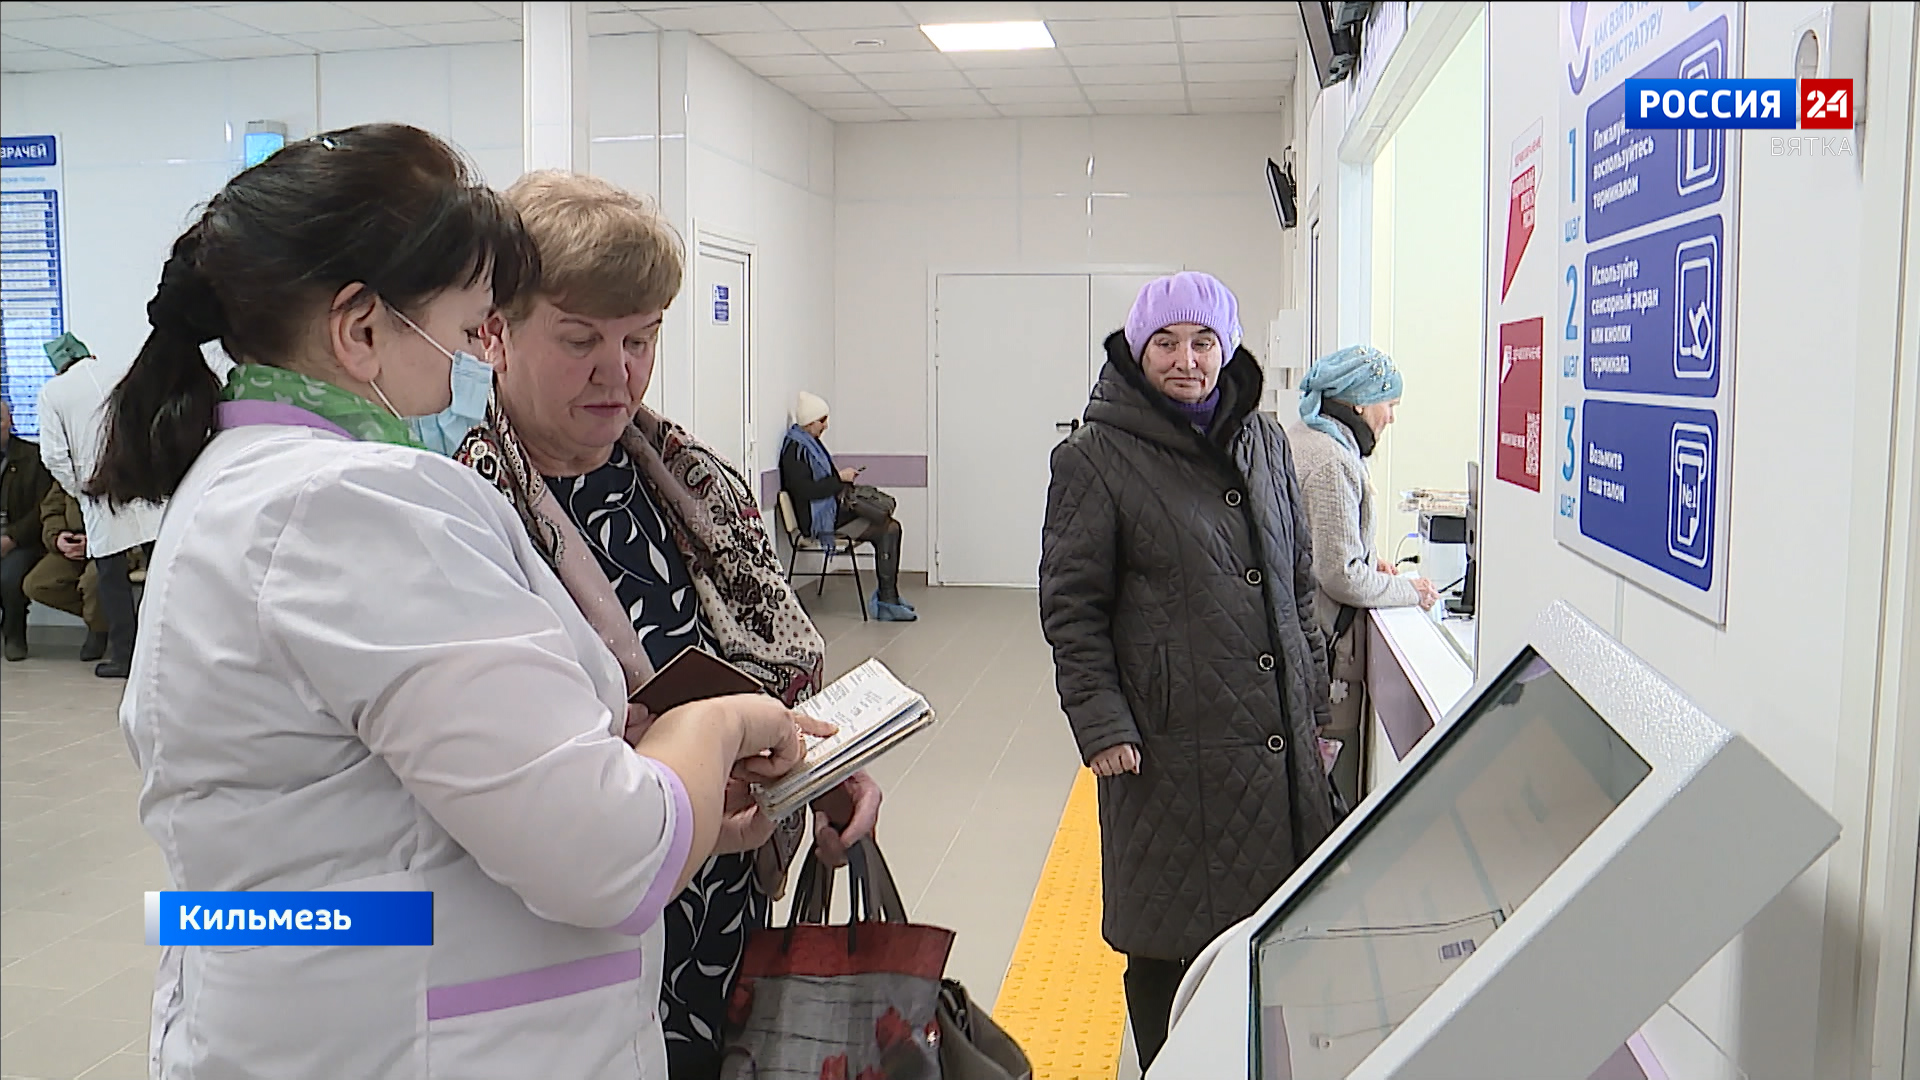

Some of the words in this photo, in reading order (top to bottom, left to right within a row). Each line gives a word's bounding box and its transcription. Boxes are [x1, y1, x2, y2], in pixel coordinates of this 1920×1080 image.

[1594, 59, 1599, 82] В
[1600, 6, 1663, 77] РЕГИСТРАТУРУ
[1569, 128, 1576, 203] 1
[1593, 136, 1654, 181] воспользуйтесь
[1593, 174, 1639, 213] терминалом
[1565, 216, 1581, 243] шаг
[1591, 257, 1639, 287] Используйте
[1566, 265, 1578, 340] 2
[1591, 288, 1631, 318] сенсорный
[1632, 288, 1659, 315] экран
[1591, 327, 1604, 344] или
[1604, 324, 1631, 343] кнопки
[1564, 355, 1579, 377] шаг
[1591, 355, 1630, 379] терминала
[1563, 406, 1575, 481] 3
[1589, 442, 1623, 471] Возьмите
[1588, 476, 1603, 496] ваш
[1603, 480, 1625, 503] талон
[1683, 483, 1697, 508] №1
[1561, 494, 1576, 519] шаг
